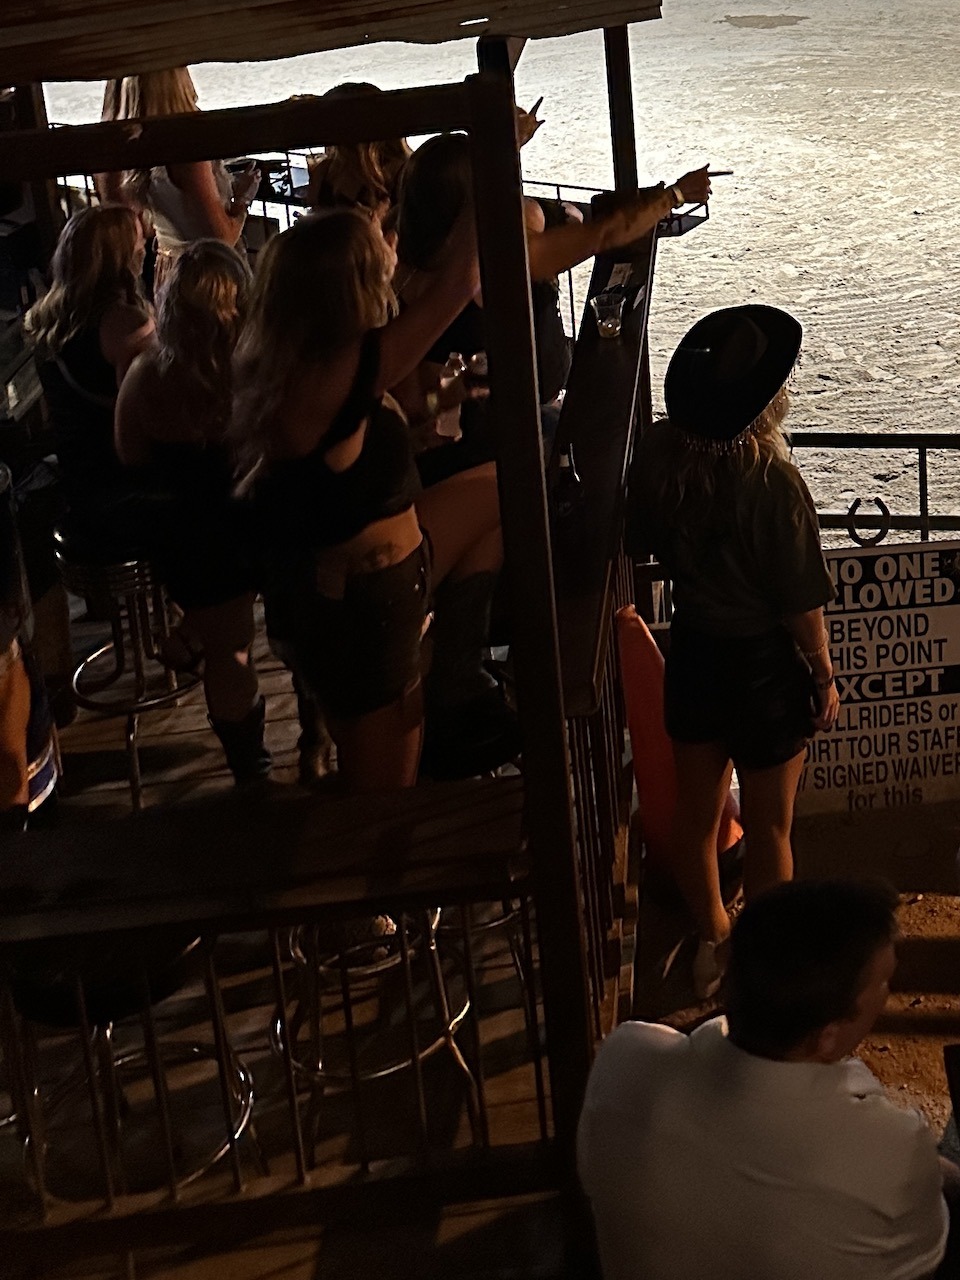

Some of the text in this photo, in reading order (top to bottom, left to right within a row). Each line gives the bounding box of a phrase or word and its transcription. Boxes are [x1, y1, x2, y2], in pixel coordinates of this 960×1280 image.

[874, 552, 940, 582] ONE
[823, 578, 955, 612] LLOWED
[830, 613, 929, 644] BEYOND
[830, 638, 948, 671] HIS POINT
[838, 668, 945, 701] XCEPT
[822, 700, 958, 733] LLRIDERS or
[846, 732, 901, 760] TOUR
[813, 760, 888, 791] SIGNED
[846, 783, 924, 811] for this
